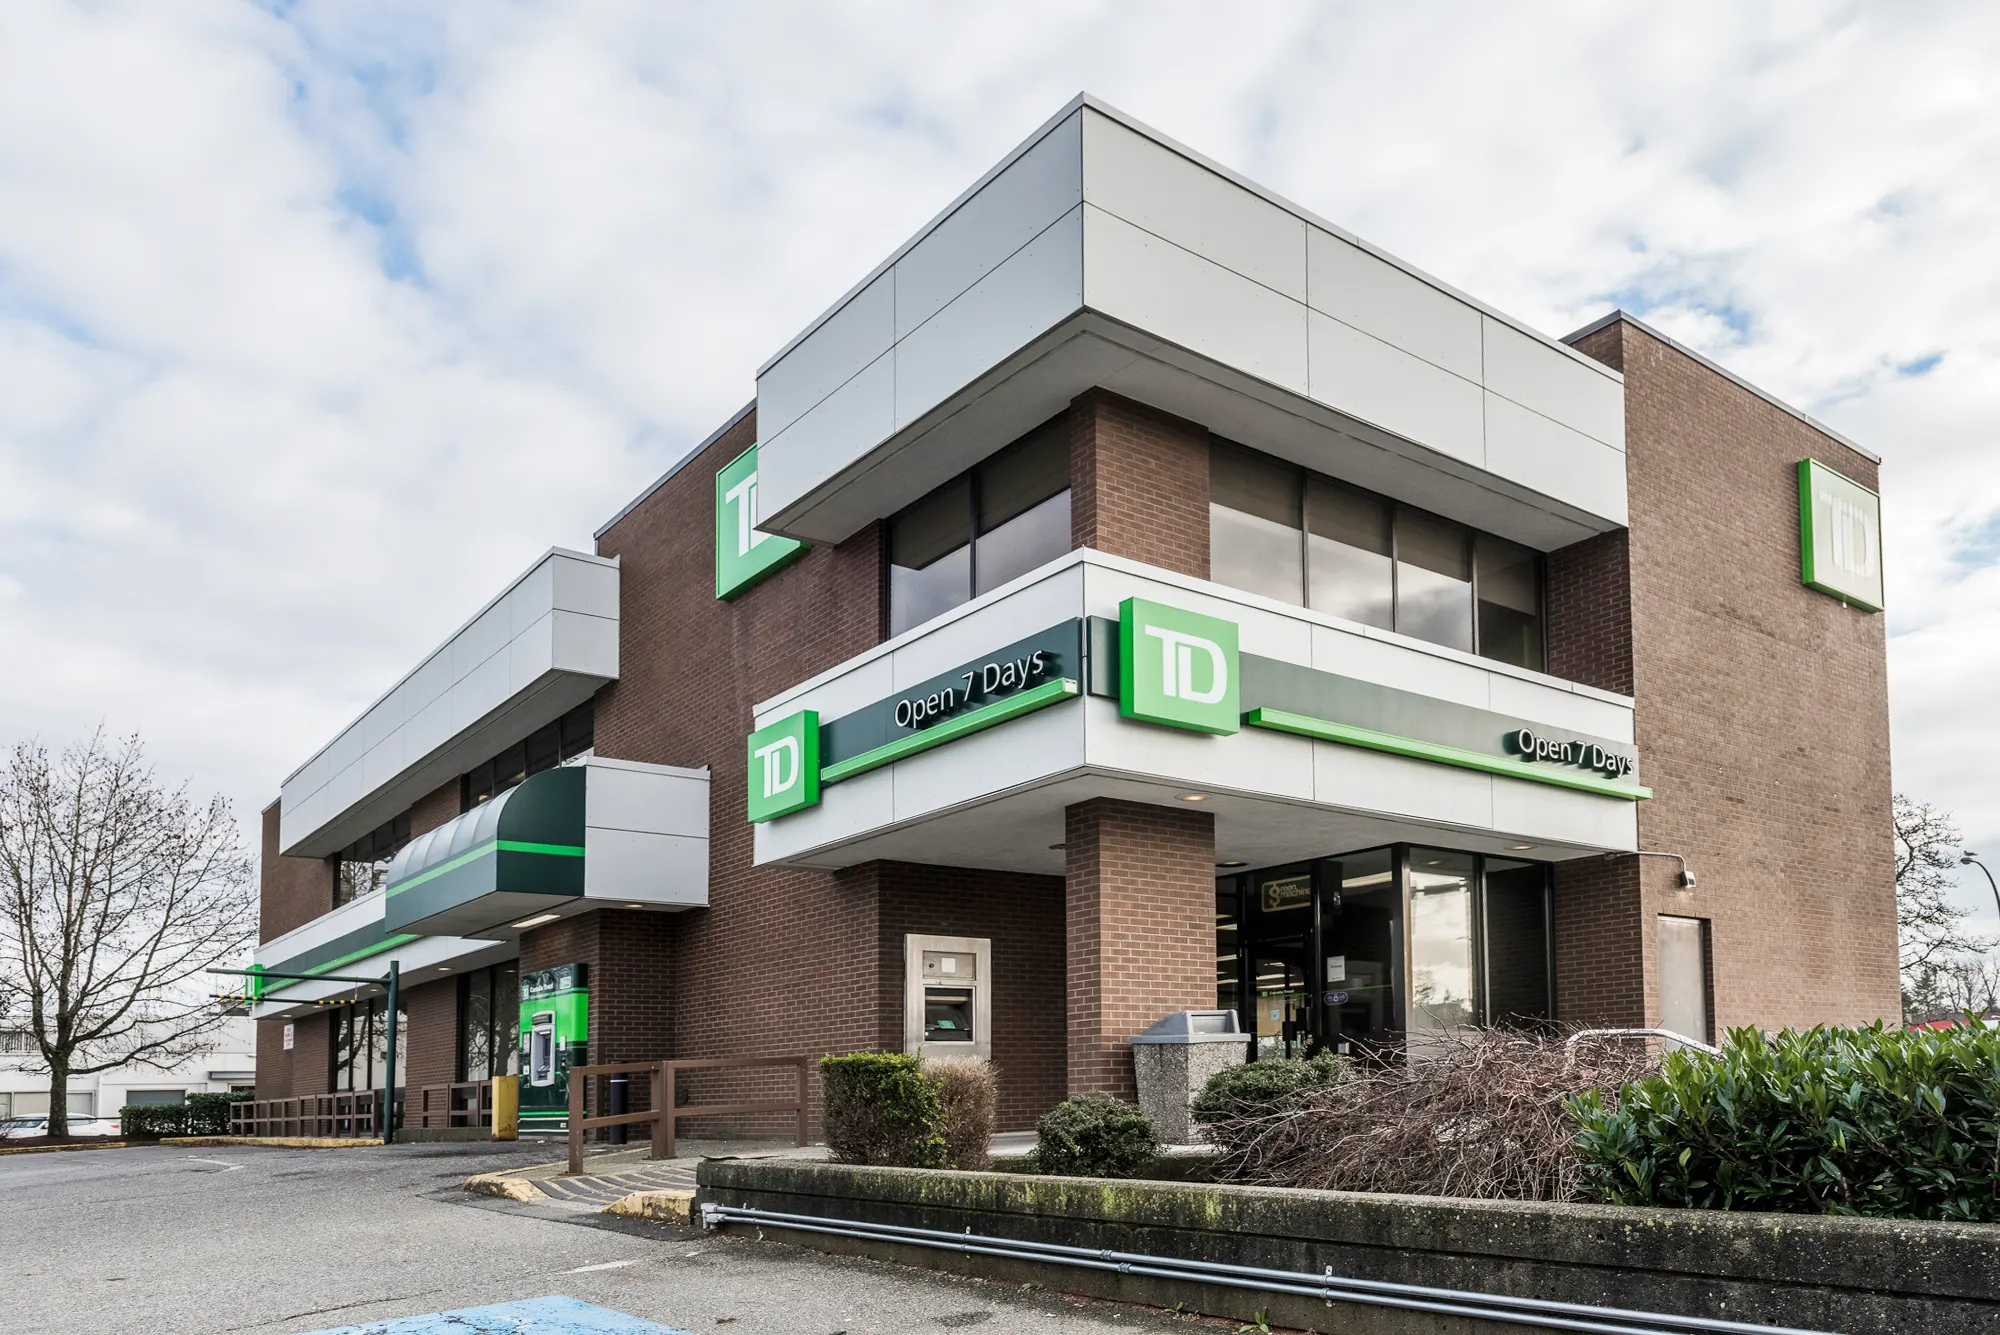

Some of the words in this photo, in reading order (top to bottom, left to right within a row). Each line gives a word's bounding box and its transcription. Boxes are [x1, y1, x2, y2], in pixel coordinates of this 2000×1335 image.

[1818, 488, 1875, 578] TD
[894, 686, 954, 730] Open
[960, 673, 976, 702] 7
[982, 649, 1045, 695] Days
[1144, 623, 1228, 705] TD
[753, 735, 800, 799] TD
[1518, 728, 1572, 763] Open
[1575, 740, 1587, 764] 7
[1592, 744, 1635, 778] Days
